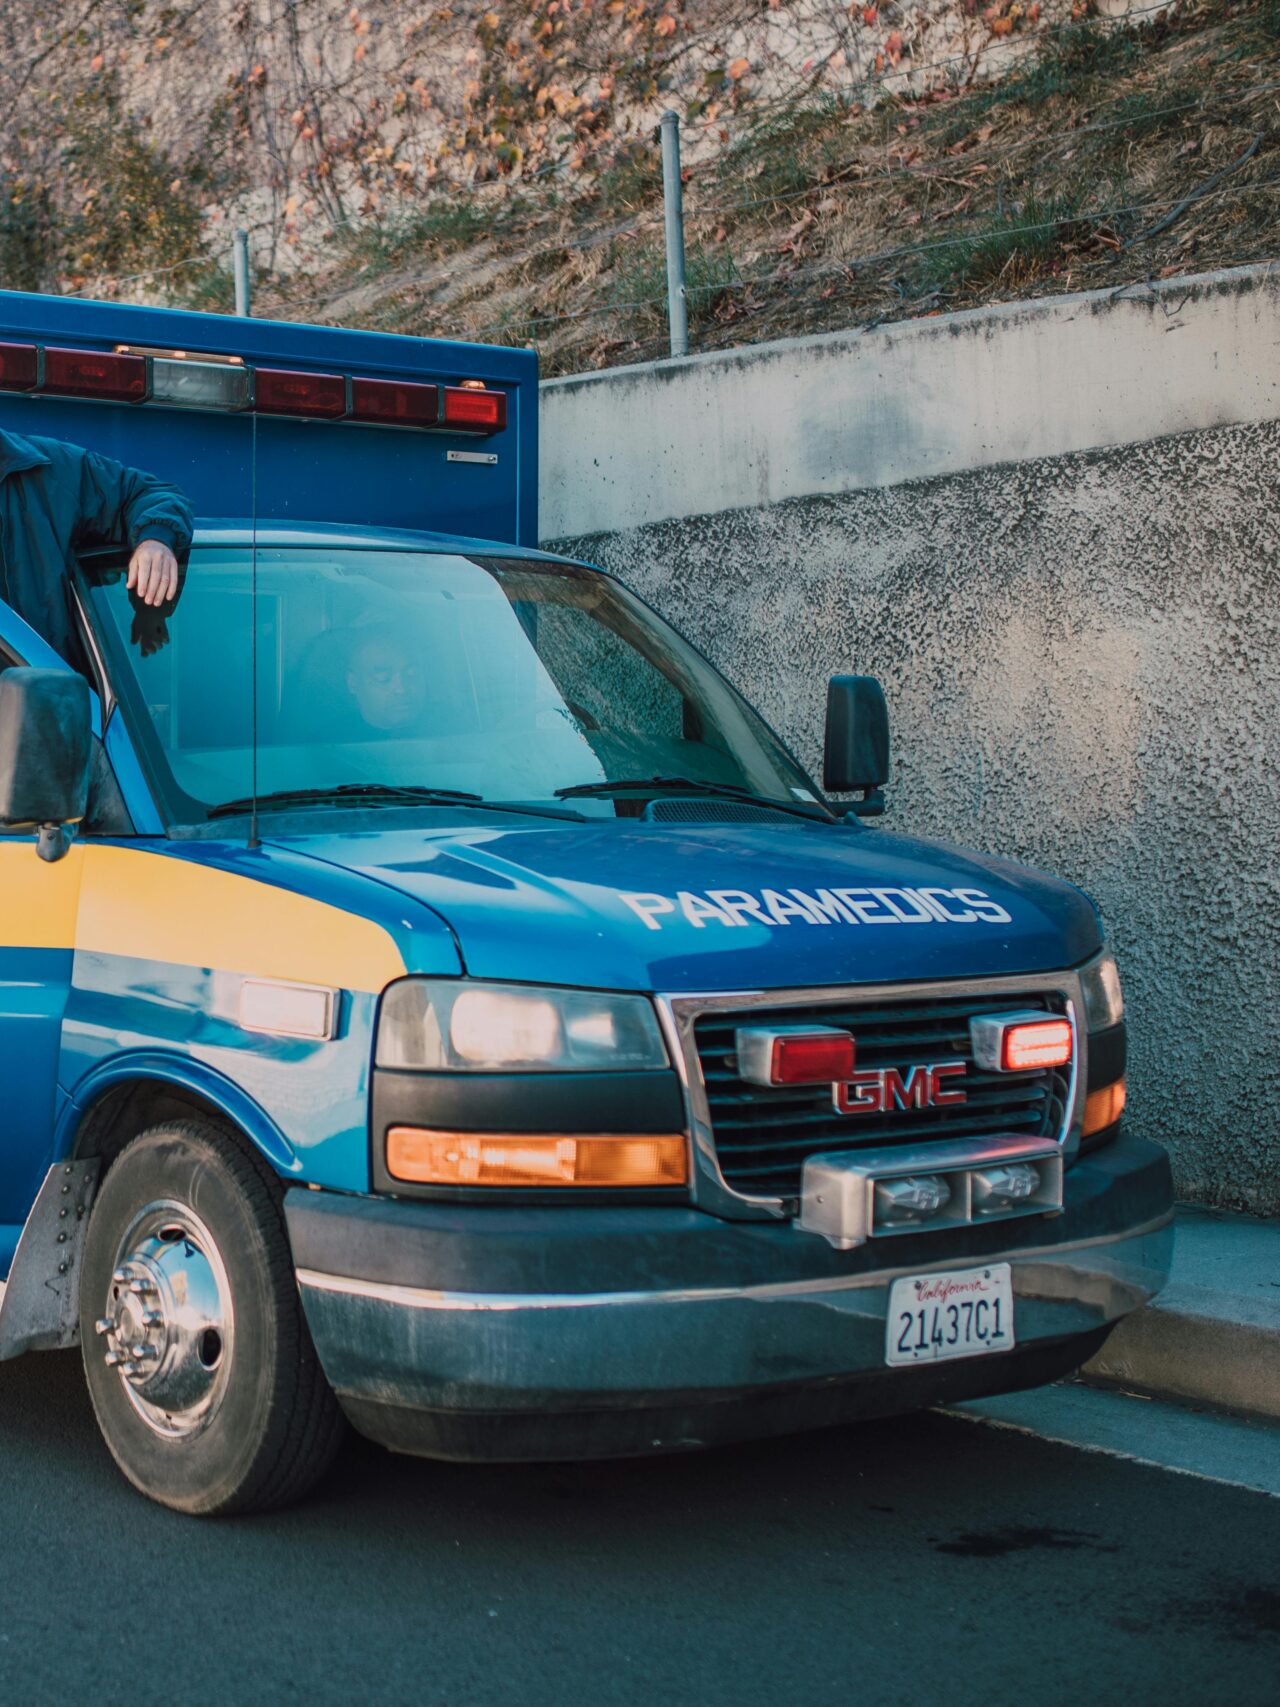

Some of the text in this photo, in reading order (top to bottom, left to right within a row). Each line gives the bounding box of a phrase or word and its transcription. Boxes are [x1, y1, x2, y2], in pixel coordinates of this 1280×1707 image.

[619, 887, 1012, 930] PARAMEDICS
[832, 1061, 967, 1114] GMC
[917, 1278, 989, 1303] California
[897, 1297, 1005, 1353] 21437C1
